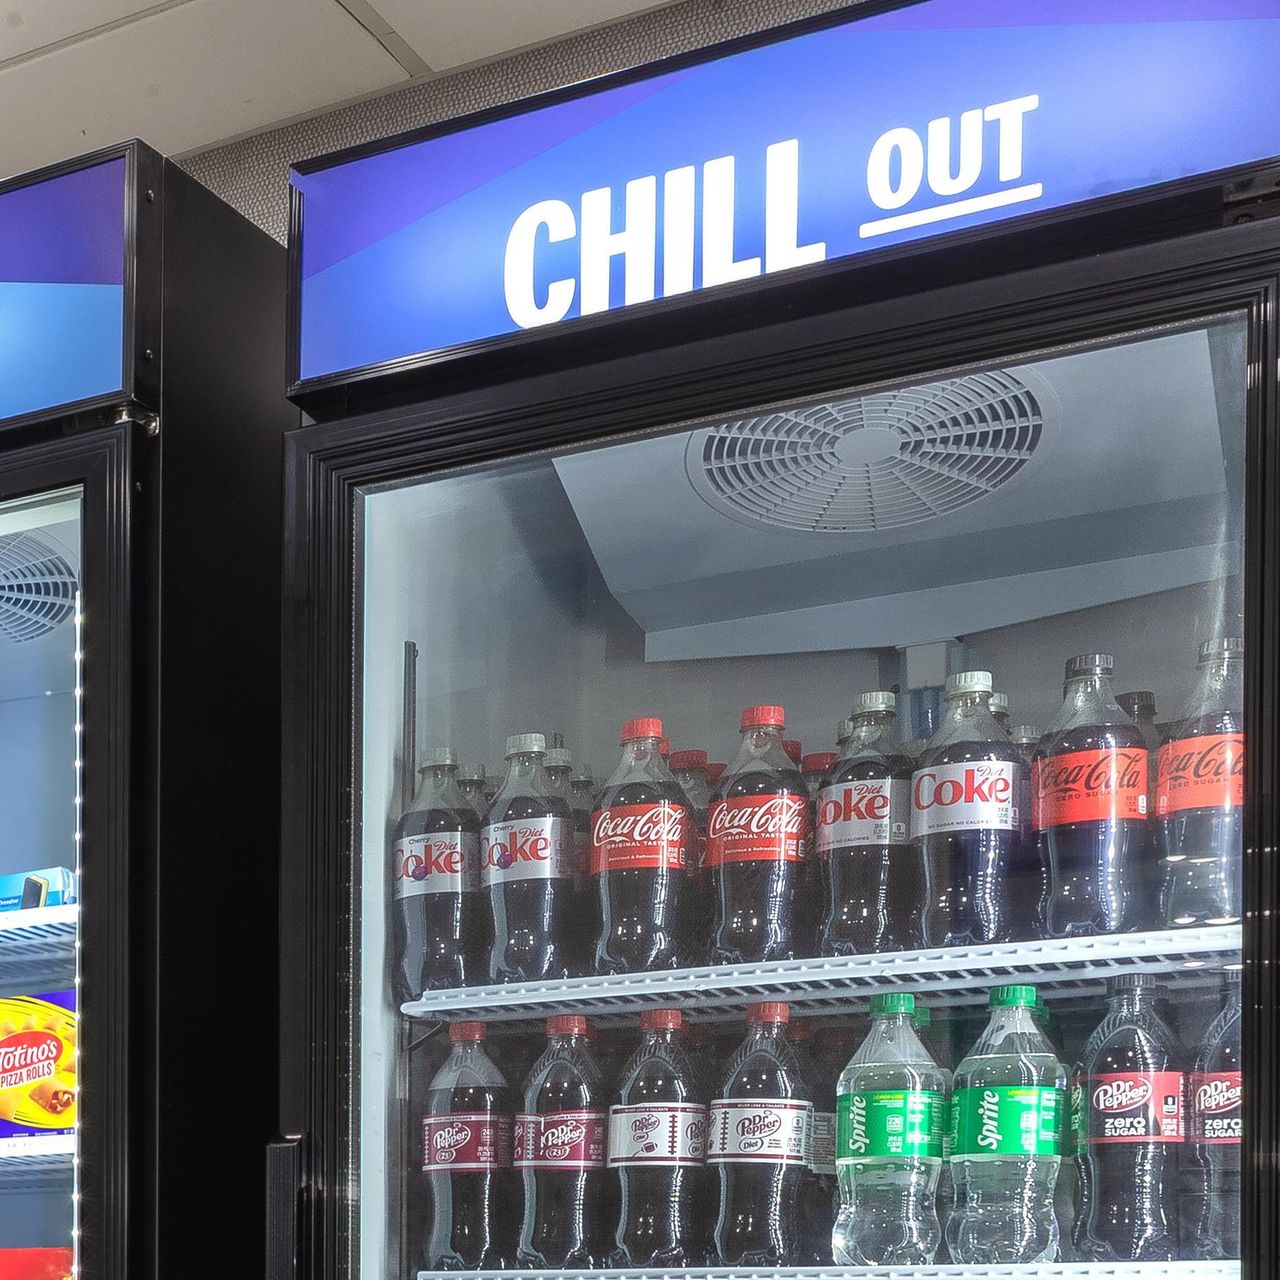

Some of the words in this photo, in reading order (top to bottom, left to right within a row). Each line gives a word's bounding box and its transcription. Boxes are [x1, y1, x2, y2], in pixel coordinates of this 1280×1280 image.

[504, 139, 825, 328] CHILL
[866, 95, 1039, 209] OUT
[915, 770, 1010, 811] Coke
[593, 806, 685, 847] Coca-Cola
[710, 797, 803, 838] Coca-Cola
[408, 836, 430, 845] Cherry
[0, 1074, 24, 1088] PIZZA
[26, 1062, 52, 1081] ROLLS
[849, 1095, 866, 1153] Sprite
[977, 1088, 1000, 1150] Sprite
[1105, 1117, 1146, 1129] zero
[1105, 1127, 1146, 1137] SUGAR
